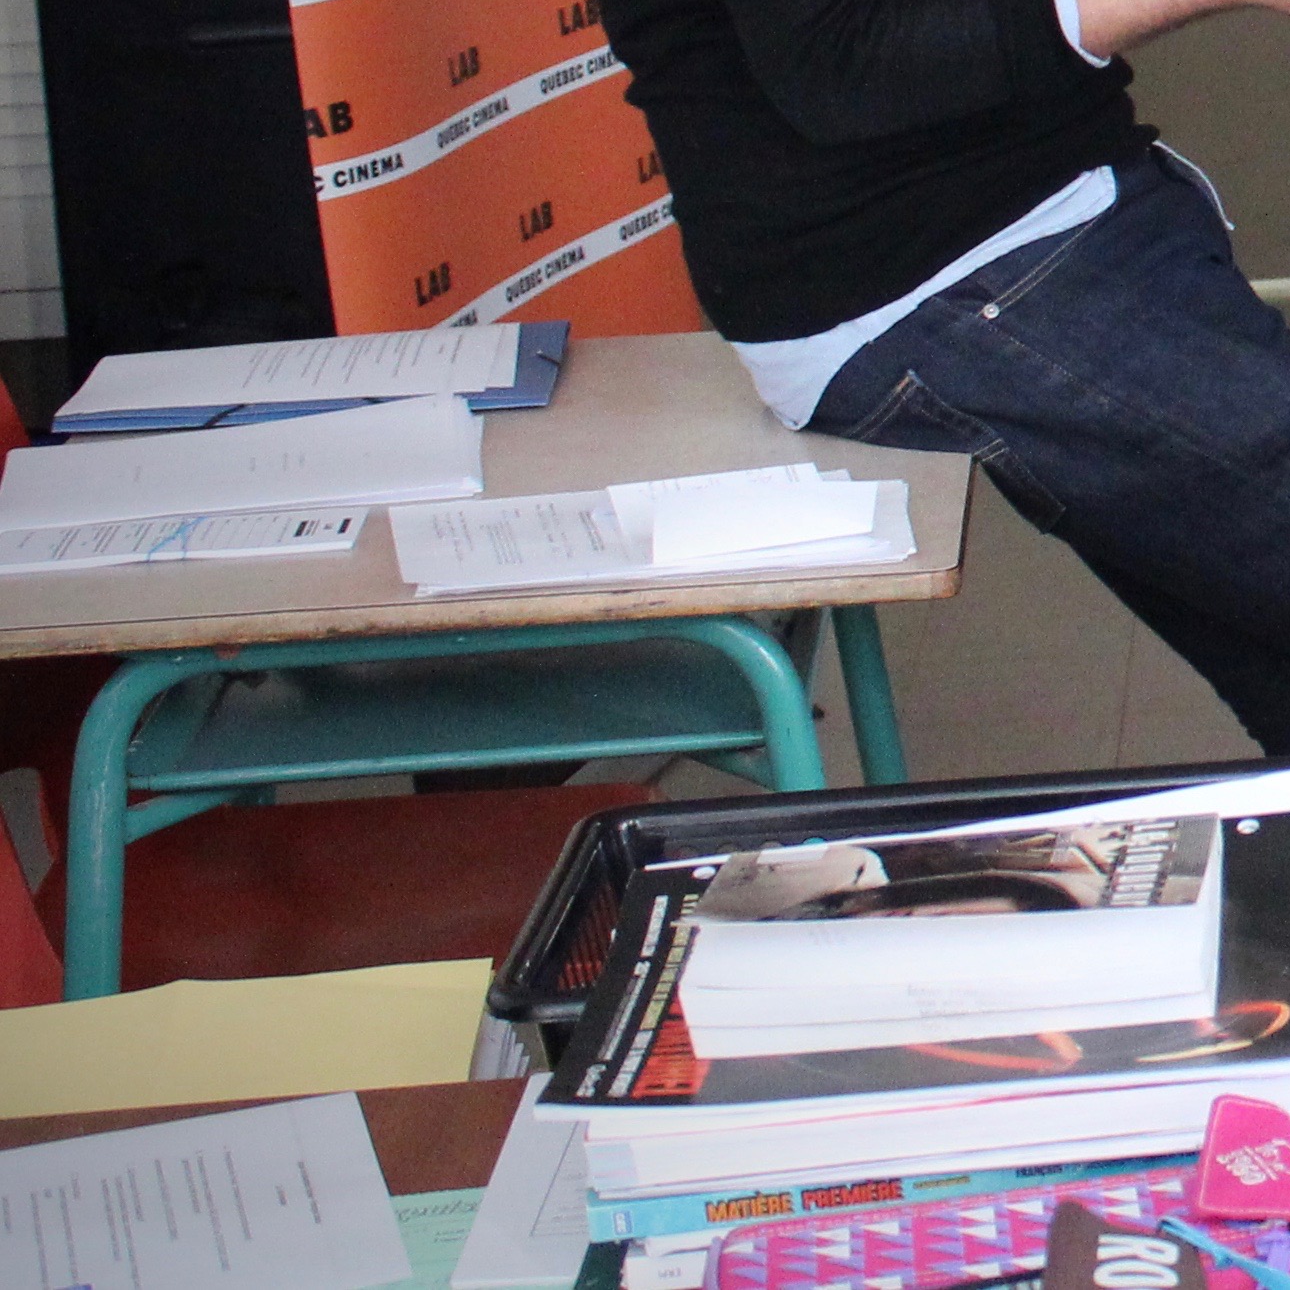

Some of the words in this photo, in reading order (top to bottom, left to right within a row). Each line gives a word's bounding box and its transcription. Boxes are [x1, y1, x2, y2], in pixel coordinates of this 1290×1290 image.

[449, 46, 481, 87] LAB
[539, 64, 585, 95] QUÉBEC
[303, 100, 355, 139] AB
[333, 153, 405, 188] CINÉMA
[637, 150, 664, 185] LA
[519, 200, 554, 244] LAB
[618, 209, 660, 242] QUÉBEC
[415, 261, 453, 307] LAB
[505, 268, 543, 303] QUÉBEC
[544, 246, 586, 280] CINÉMA
[705, 1191, 796, 1224] MATIÈRE
[802, 1177, 904, 1211] PREMIÈRE
